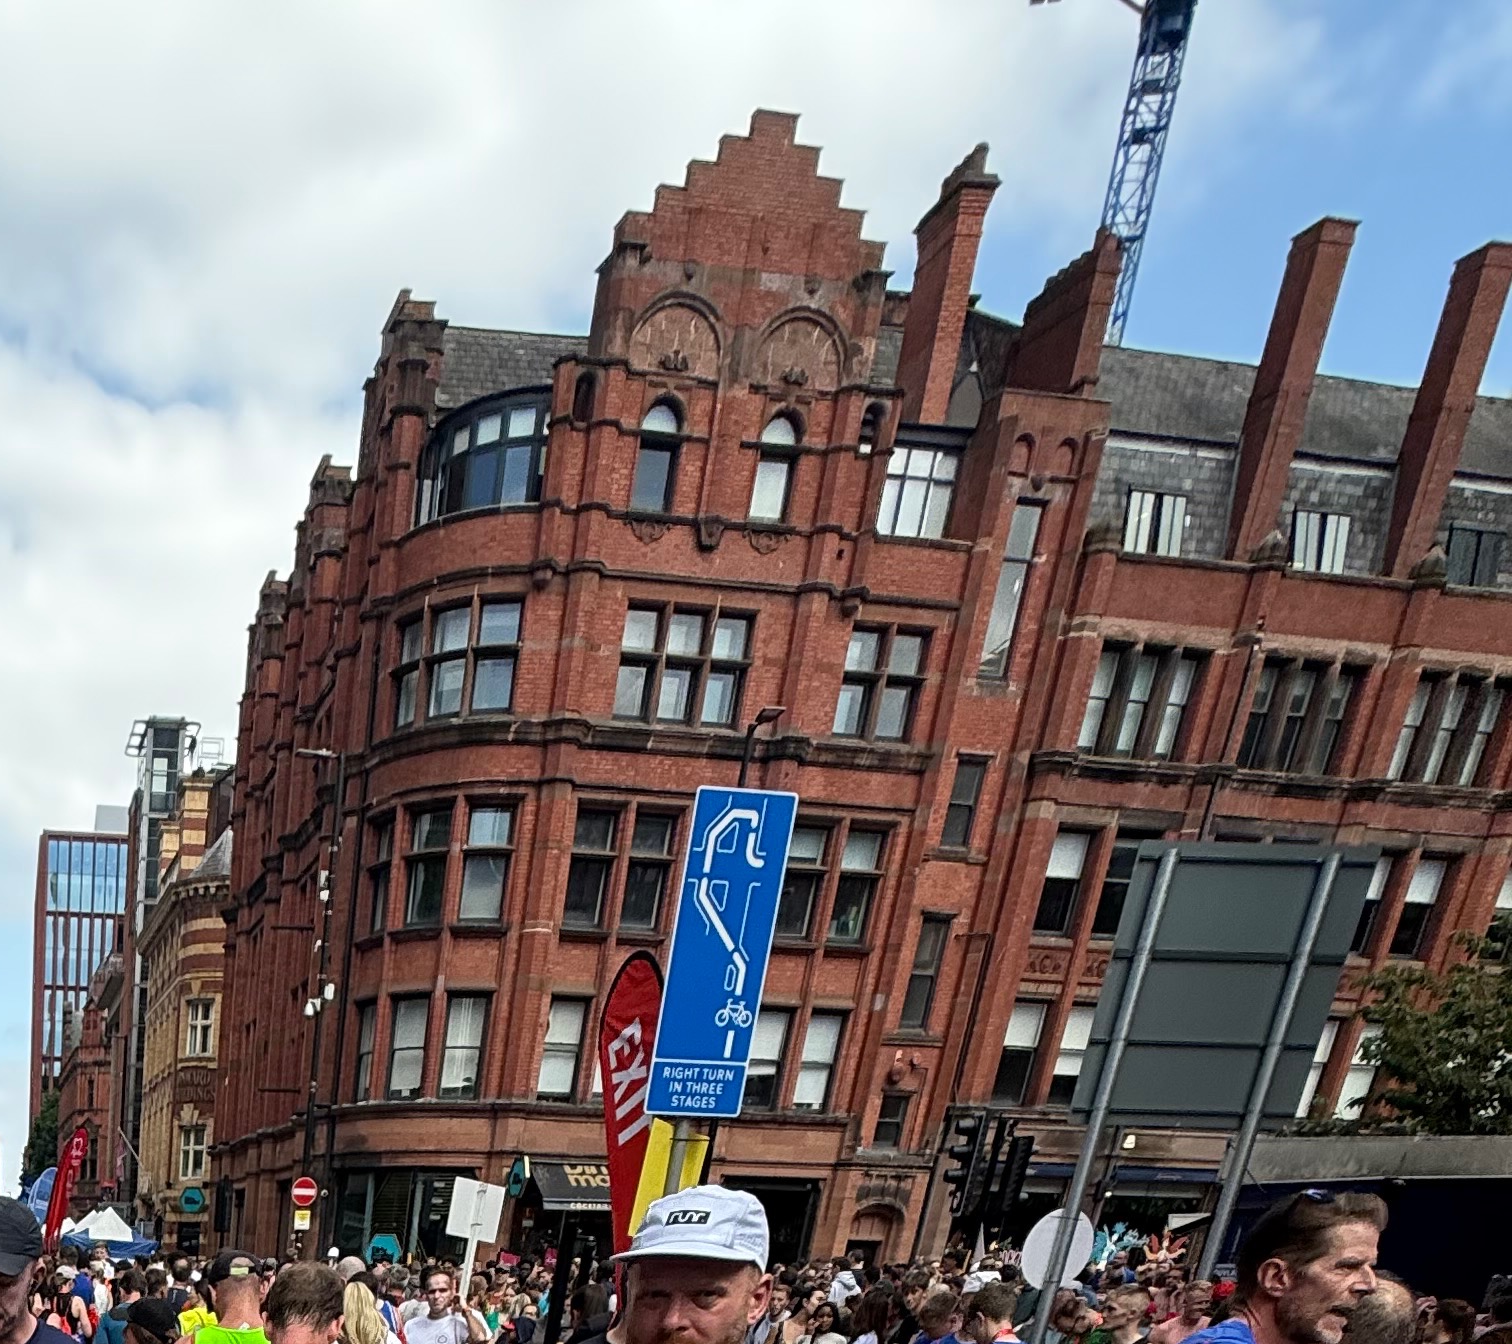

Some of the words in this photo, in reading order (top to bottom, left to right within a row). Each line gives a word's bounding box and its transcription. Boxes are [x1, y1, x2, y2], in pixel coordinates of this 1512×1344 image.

[662, 1066, 699, 1080] RIGHT
[702, 1067, 735, 1081] TURN
[668, 1082, 683, 1093] IN
[685, 1082, 724, 1095] THREE
[670, 1095, 716, 1109] STAGES
